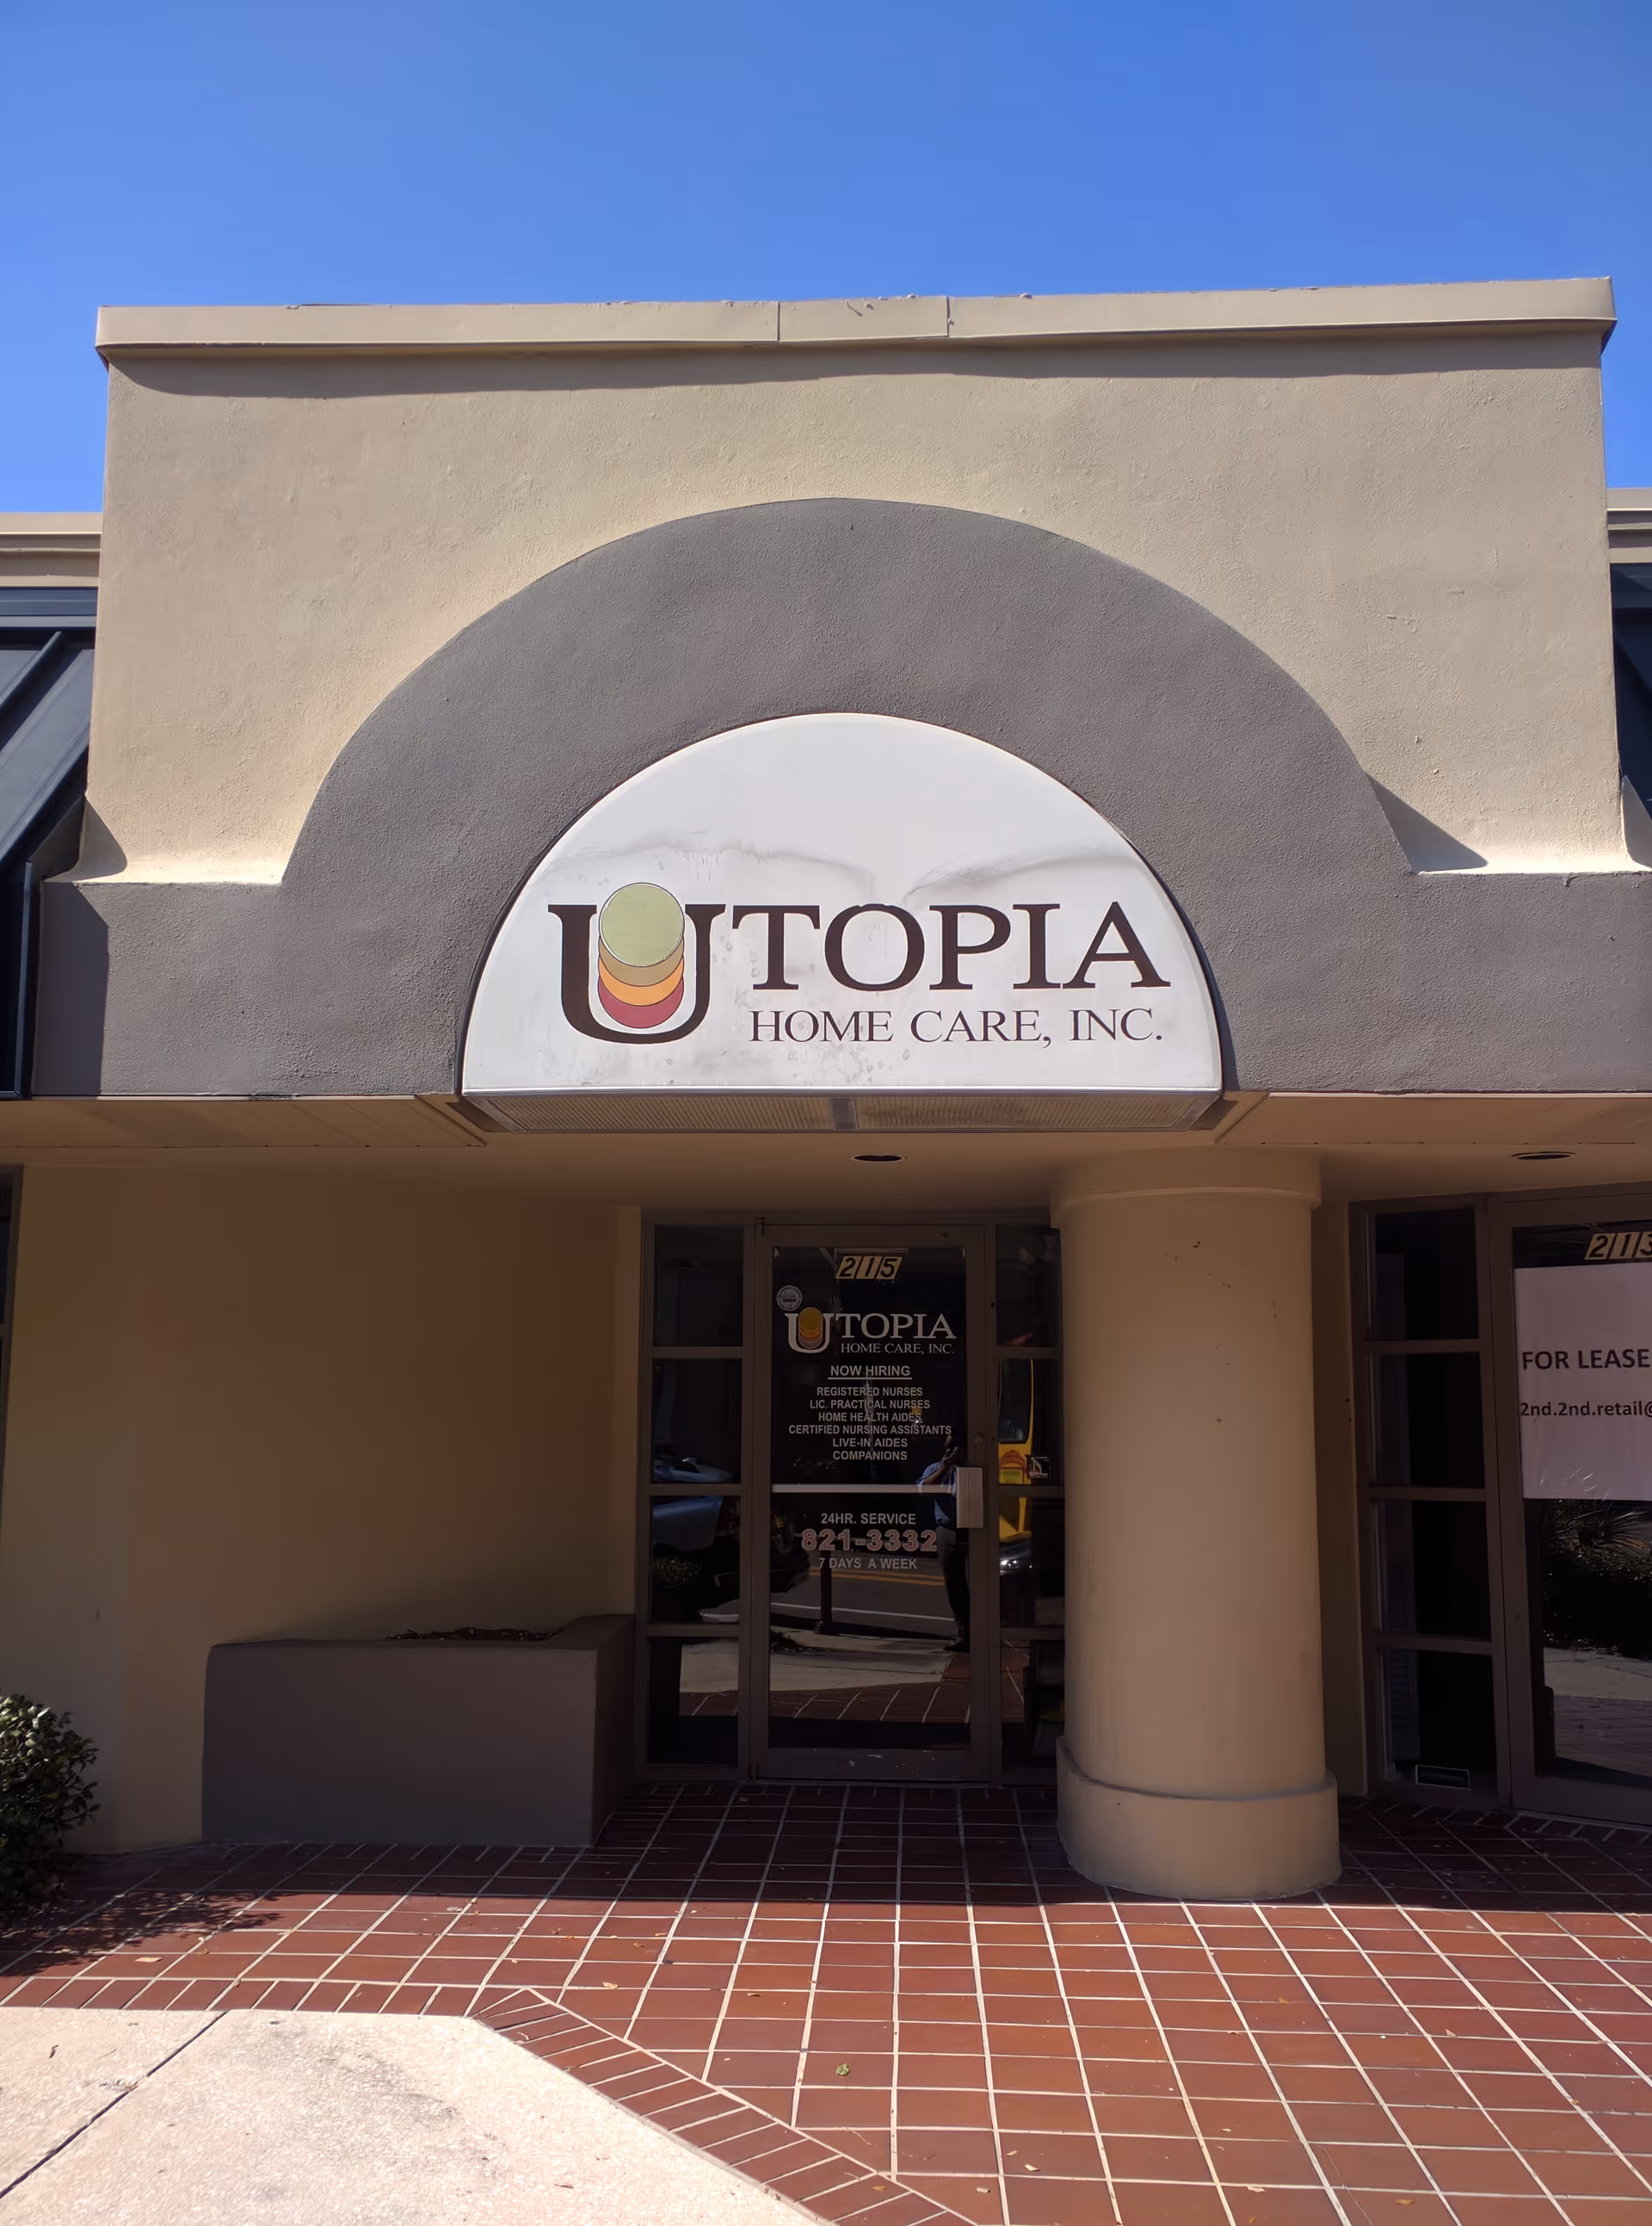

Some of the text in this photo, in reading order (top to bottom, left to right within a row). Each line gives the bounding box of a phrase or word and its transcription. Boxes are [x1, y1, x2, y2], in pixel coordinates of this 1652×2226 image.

[548, 901, 1171, 1045] UTOPIA
[749, 1008, 1162, 1049] HOME CARE, INC.
[839, 1257, 898, 1278] 215
[785, 1312, 957, 1353] UTOPIA
[841, 1343, 954, 1355] HOME CARE, INC.
[1522, 1348, 1650, 1370] FOR LEASE
[830, 1366, 911, 1377] NOW HIRING
[817, 1387, 923, 1397] REGISTERED NURSES
[810, 1399, 930, 1409] LIC. PRACTICAL NURSES
[818, 1412, 922, 1421] HOME HEALTH AIDES
[788, 1425, 952, 1434] CERTIFIED NURSING ASSISTANTS
[833, 1438, 908, 1447] LIVE-IN AIDES
[833, 1451, 908, 1460] COMPANIONS
[821, 1514, 916, 1525] 24HR. SERVICE
[801, 1529, 937, 1551] 821-3332
[819, 1557, 917, 1569] 7 DAYS A WEEK
